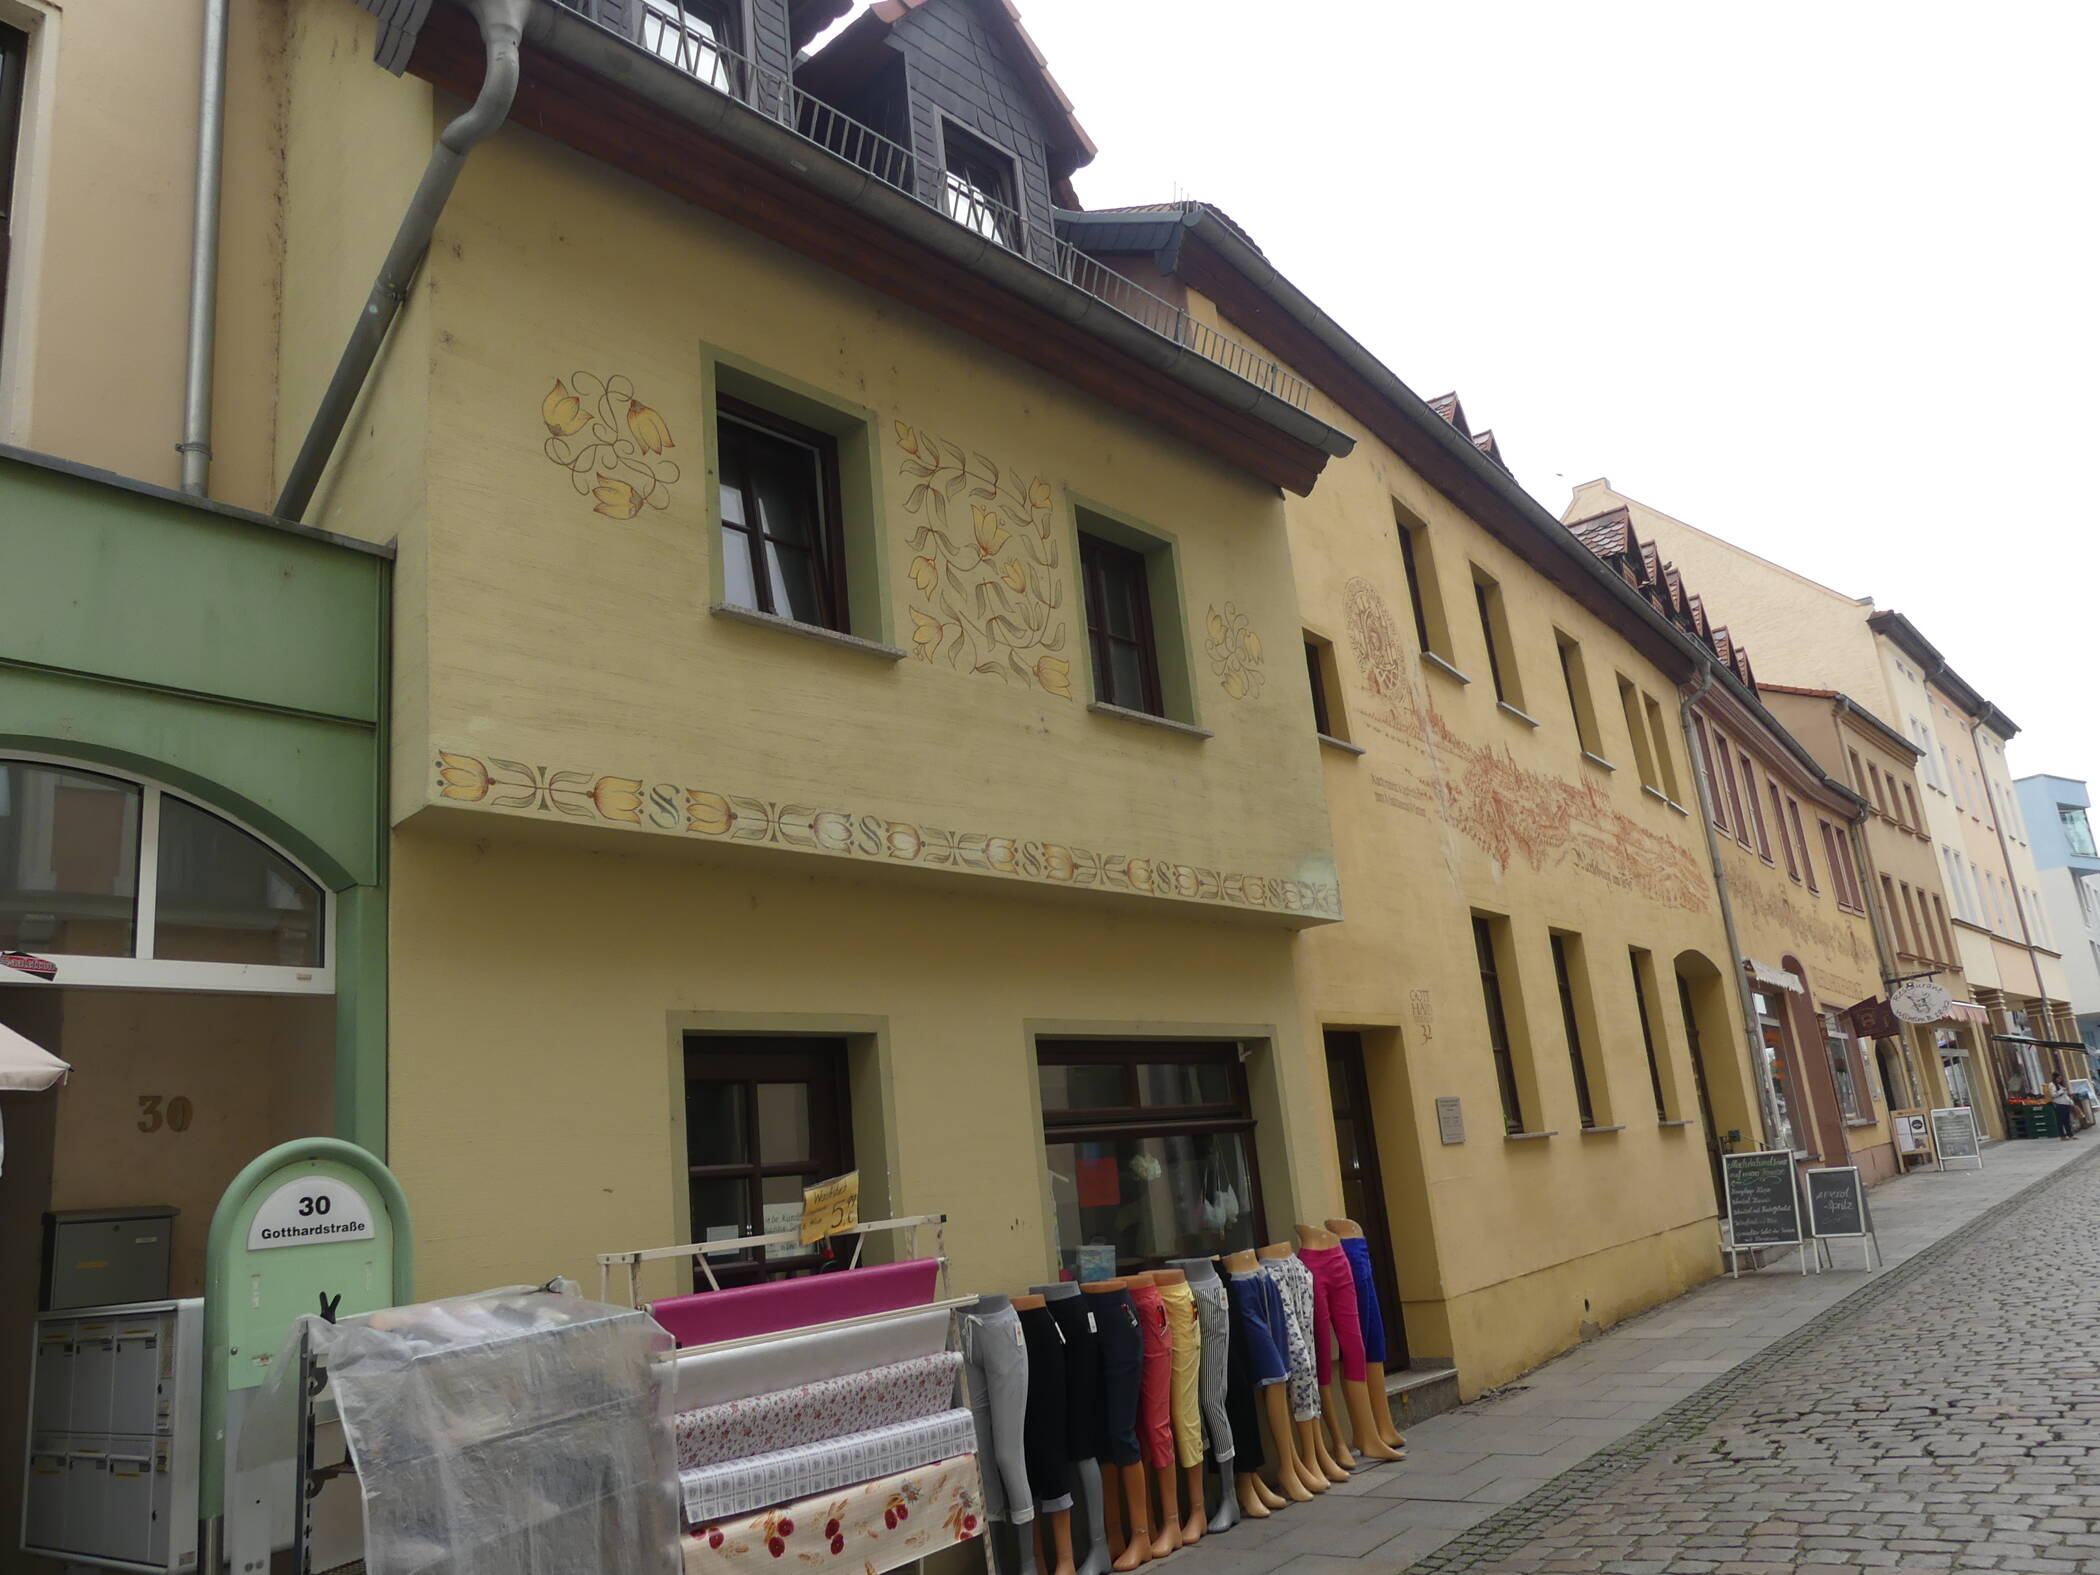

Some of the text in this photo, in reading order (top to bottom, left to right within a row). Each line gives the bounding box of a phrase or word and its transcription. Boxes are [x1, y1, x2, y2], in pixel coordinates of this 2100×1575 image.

[137, 1095, 193, 1133] 30
[298, 1195, 331, 1217] 30
[261, 1221, 365, 1239] Gotthardstraße
